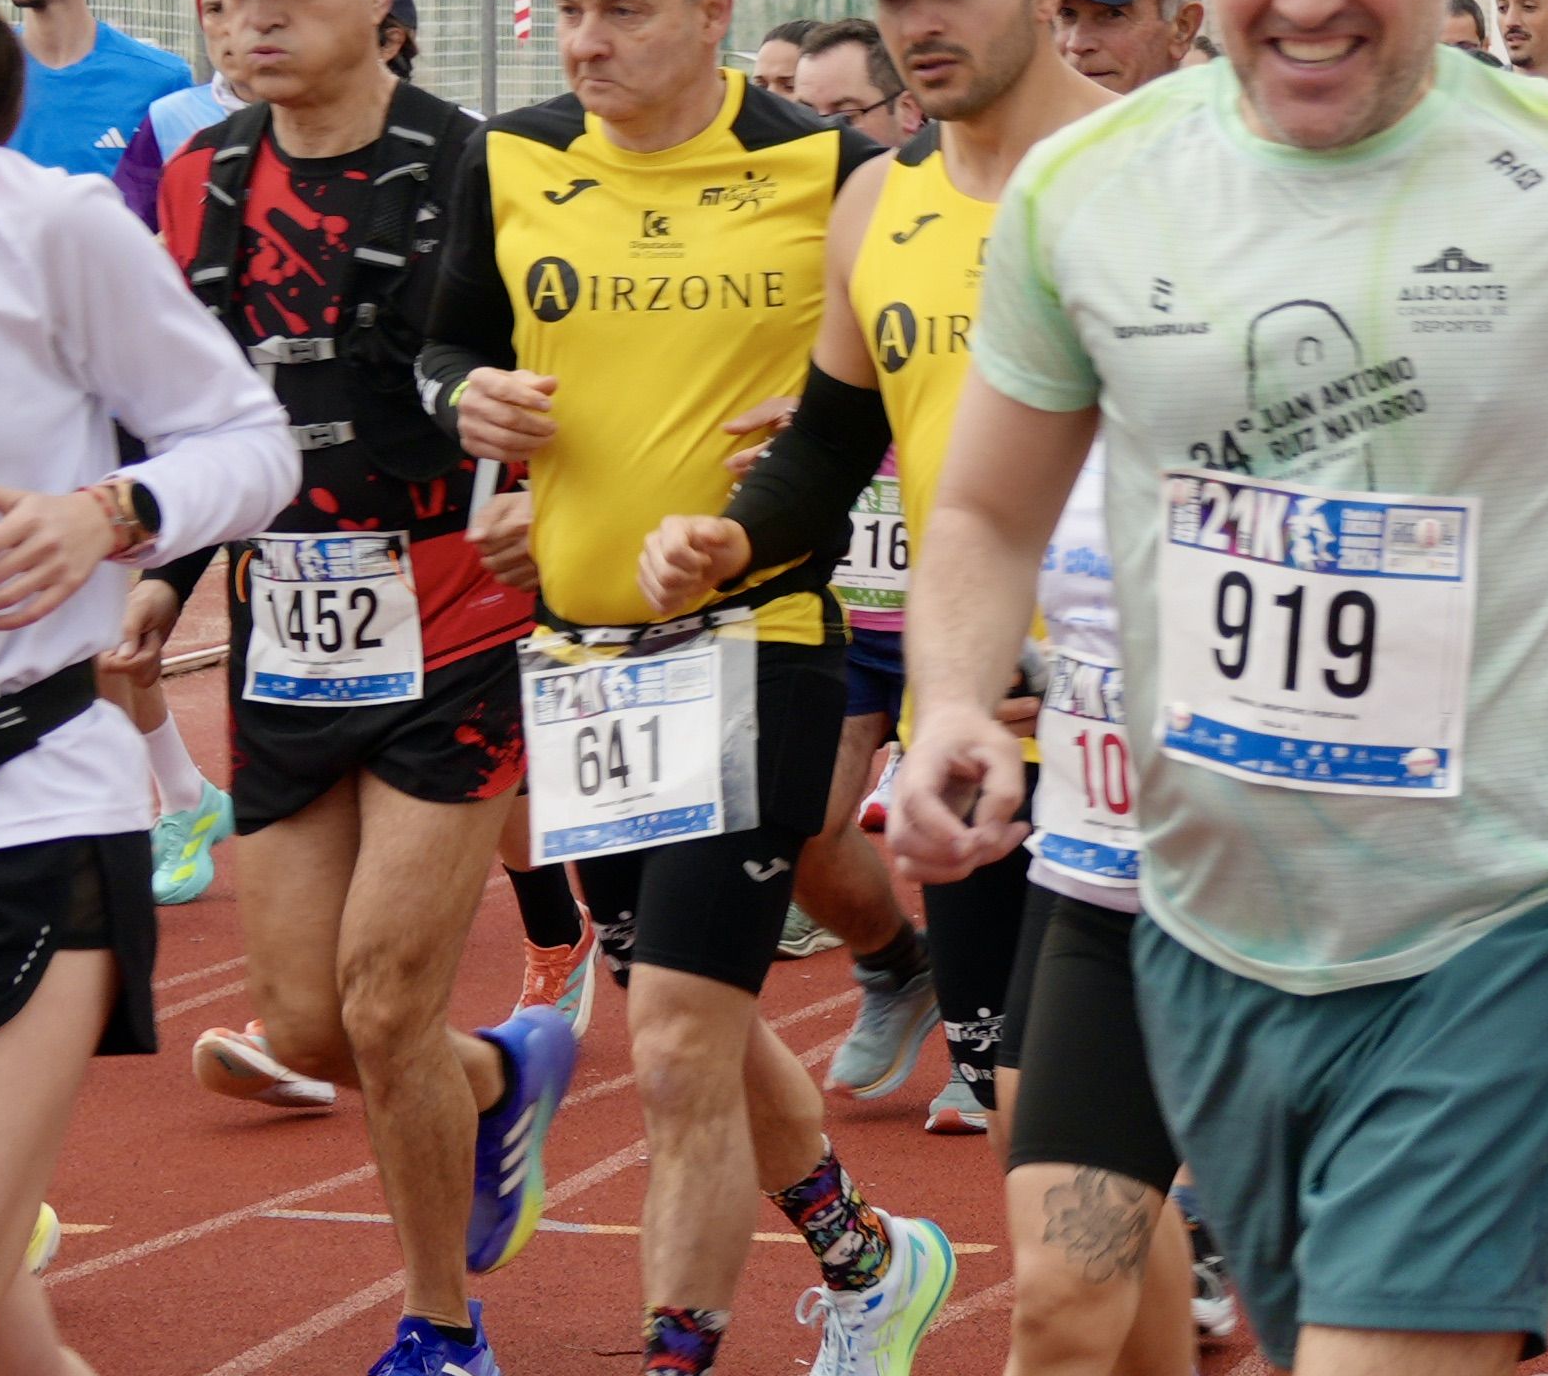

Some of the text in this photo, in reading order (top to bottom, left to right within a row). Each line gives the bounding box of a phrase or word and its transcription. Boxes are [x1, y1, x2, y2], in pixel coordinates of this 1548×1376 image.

[533, 263, 786, 311] AIRZONE
[1320, 355, 1416, 410] ANTONIO
[1322, 388, 1427, 443] NAVARRO
[836, 520, 909, 571] 16
[1200, 482, 1291, 563] 21K
[264, 586, 385, 653] 1452
[1211, 570, 1378, 699] 919
[576, 714, 661, 796] 641
